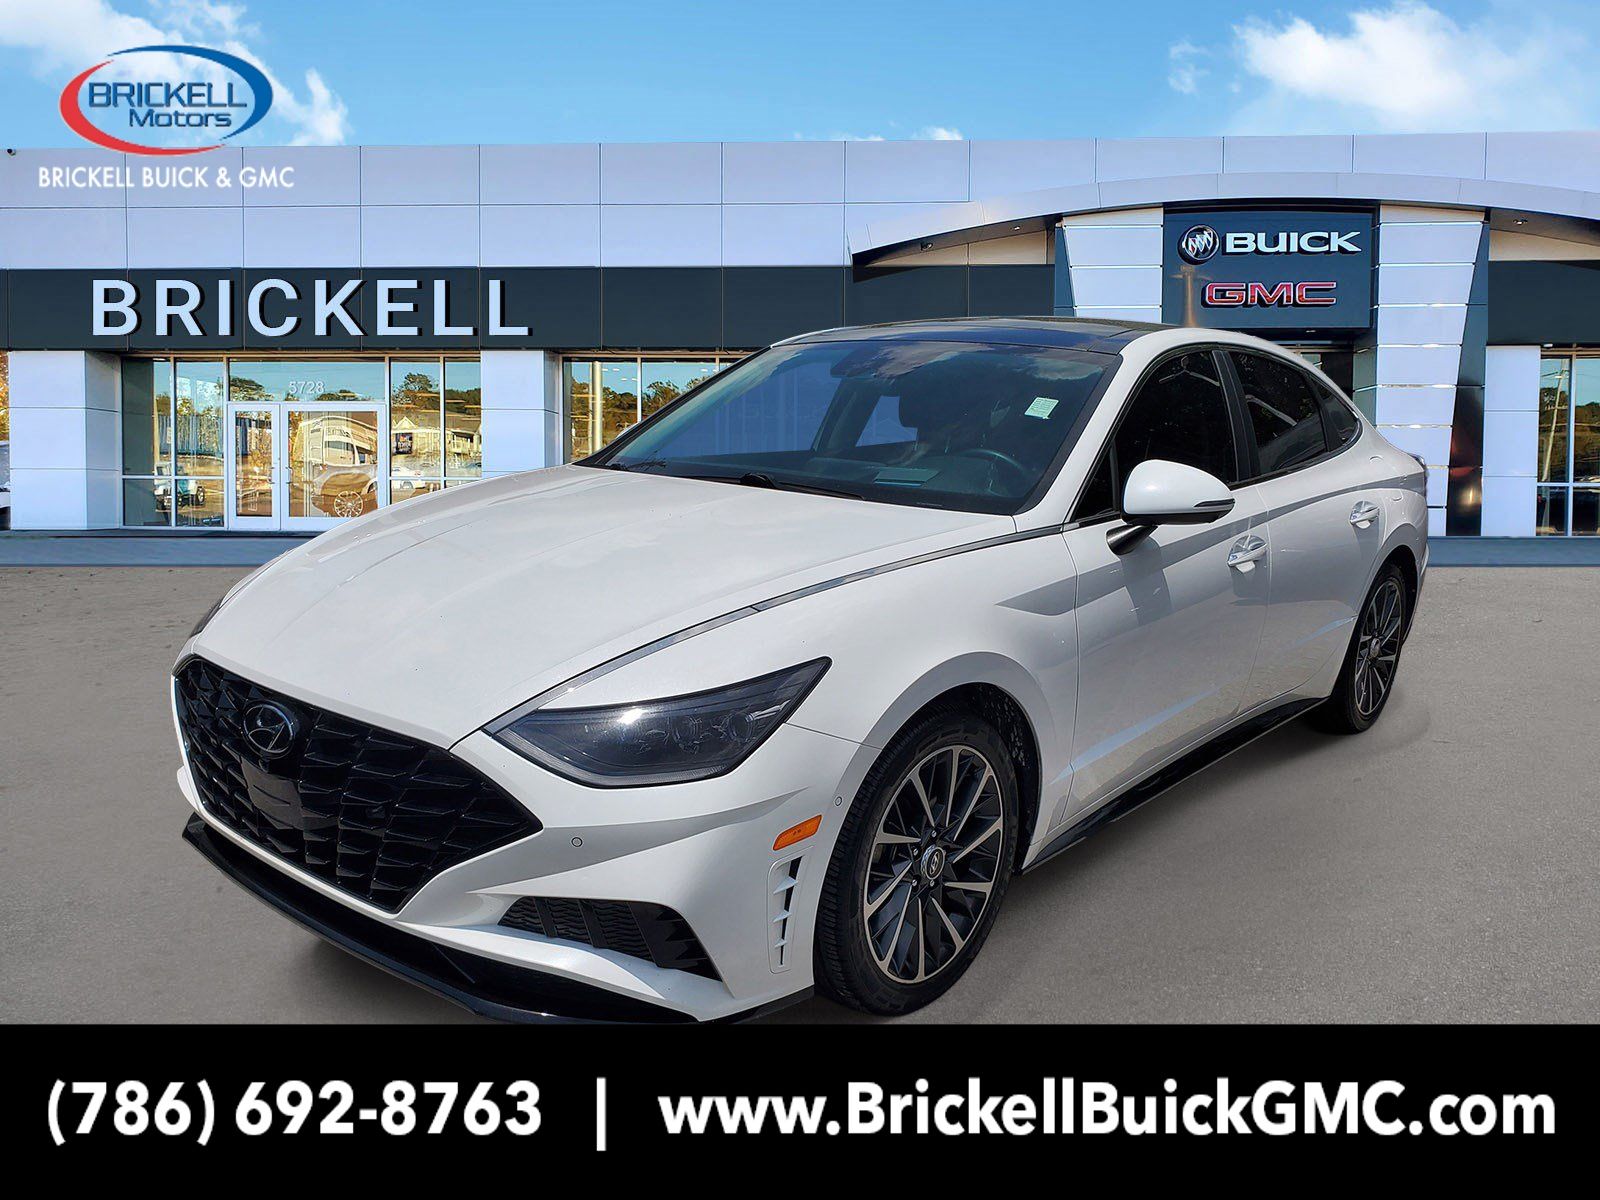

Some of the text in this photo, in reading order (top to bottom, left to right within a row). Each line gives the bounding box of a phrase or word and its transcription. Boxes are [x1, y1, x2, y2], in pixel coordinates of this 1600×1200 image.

[1225, 231, 1362, 253] BUICK
[1205, 282, 1337, 305] GMC
[92, 279, 532, 337] BRICKELL
[288, 380, 324, 394] 5728
